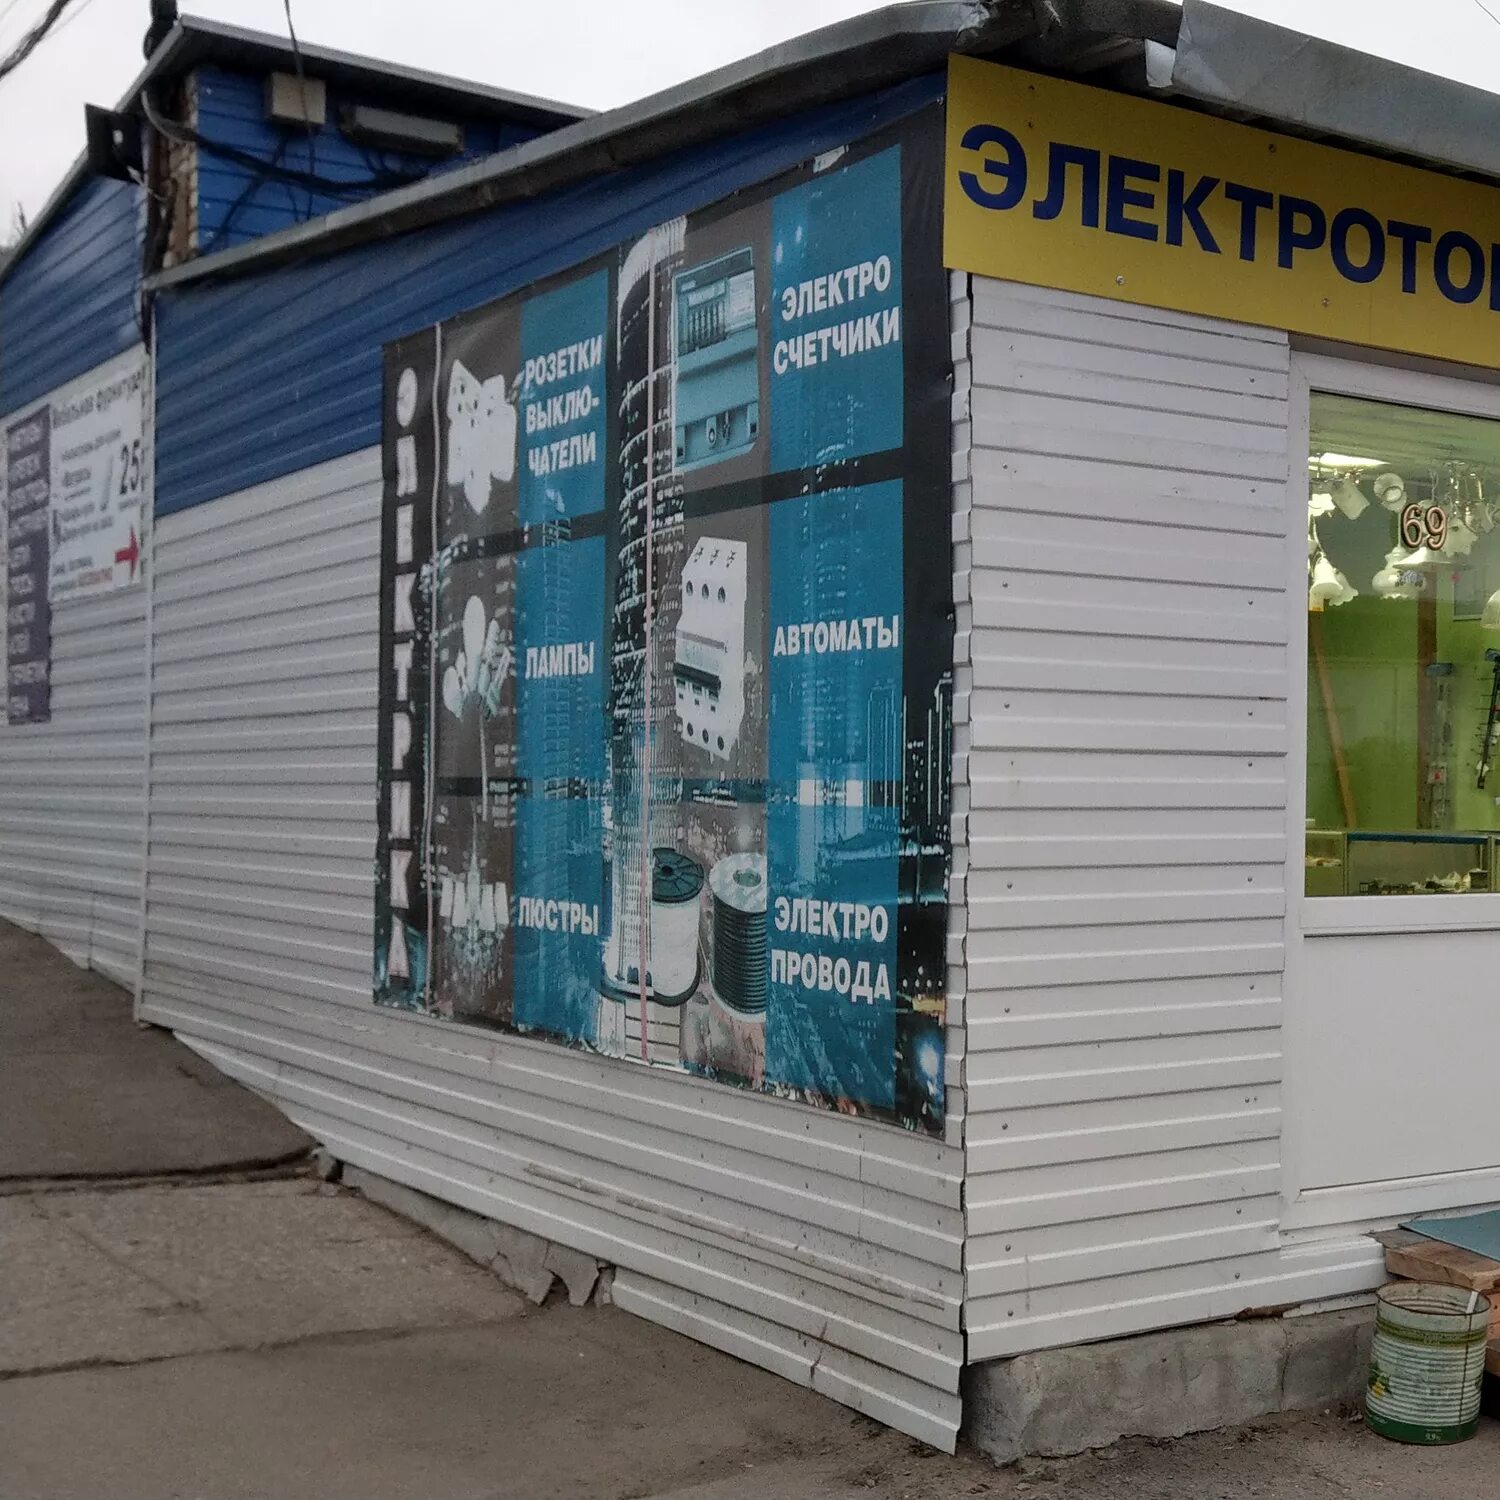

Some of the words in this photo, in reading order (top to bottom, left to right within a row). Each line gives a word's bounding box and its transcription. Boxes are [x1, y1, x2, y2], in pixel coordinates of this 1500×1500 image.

[780, 254, 892, 321] ЭЛЕКТРО
[524, 334, 603, 387] РОЗЕТКИ
[772, 305, 901, 376] СЧЕТЧИКИ
[525, 384, 600, 435] ВЫКЛЮ-
[527, 432, 597, 478] ЧАТЕЛИ
[1401, 503, 1447, 550] 69
[524, 640, 595, 680] ЛАМПЫ
[772, 614, 899, 658] АВТОМАТЫ
[518, 897, 599, 937] ЛЮСТРЫ
[773, 896, 889, 944] ЭЛЕКТРО
[770, 949, 892, 1005] ПРОВОДА
